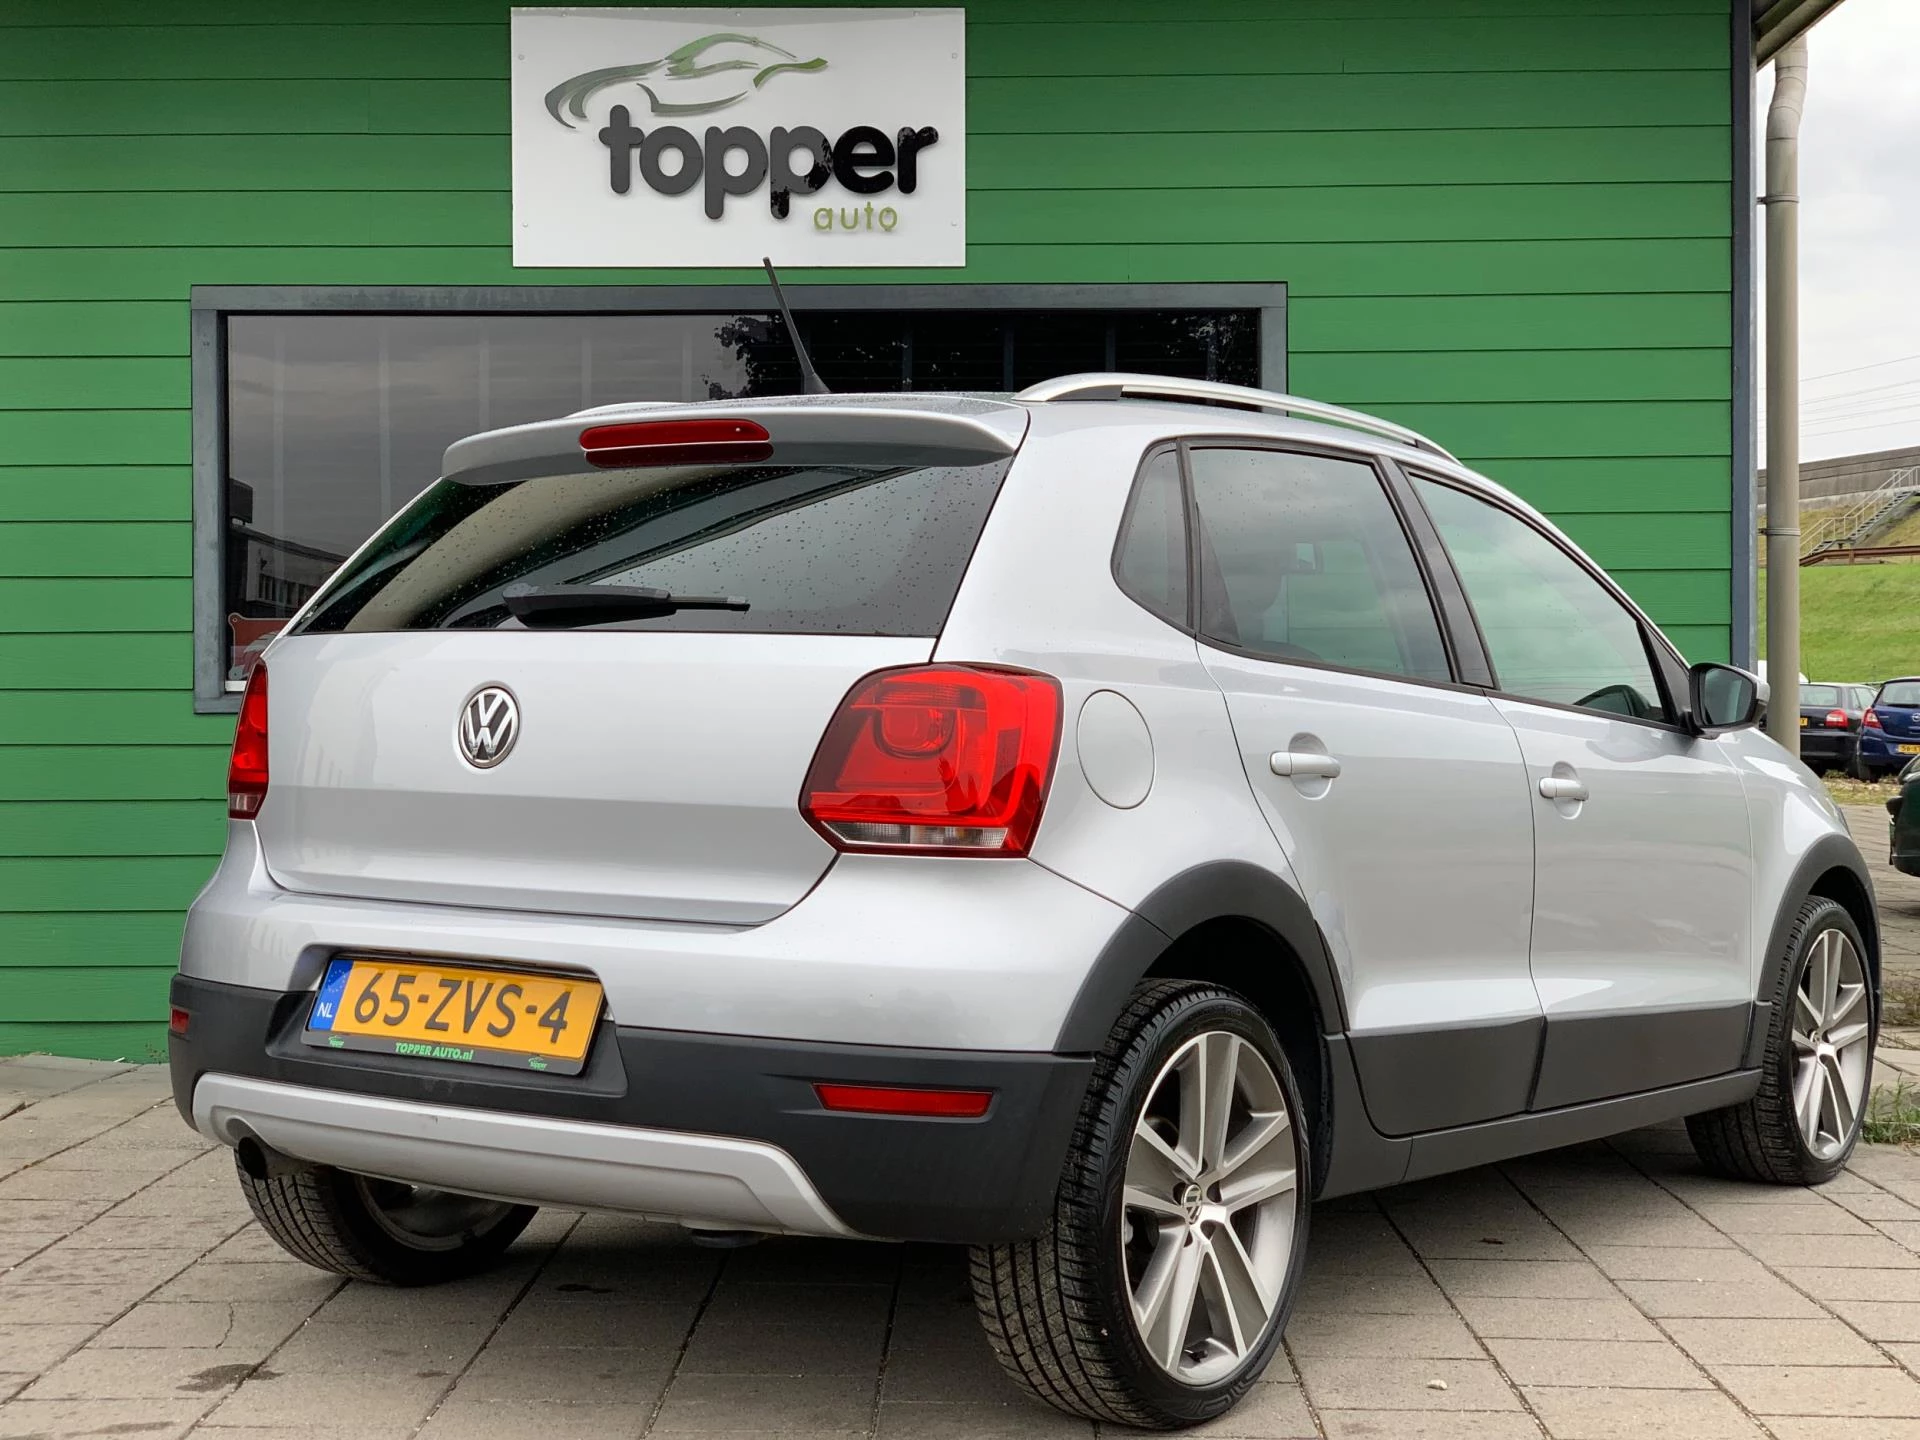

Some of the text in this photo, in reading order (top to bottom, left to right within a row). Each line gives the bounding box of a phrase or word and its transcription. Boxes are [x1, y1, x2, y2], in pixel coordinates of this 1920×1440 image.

[598, 104, 940, 219] topper
[813, 202, 898, 232] auto
[317, 1002, 333, 1019] NL
[354, 975, 571, 1043] 65-ZVS-4
[395, 1042, 474, 1061] TOPPER AUTO.nl
